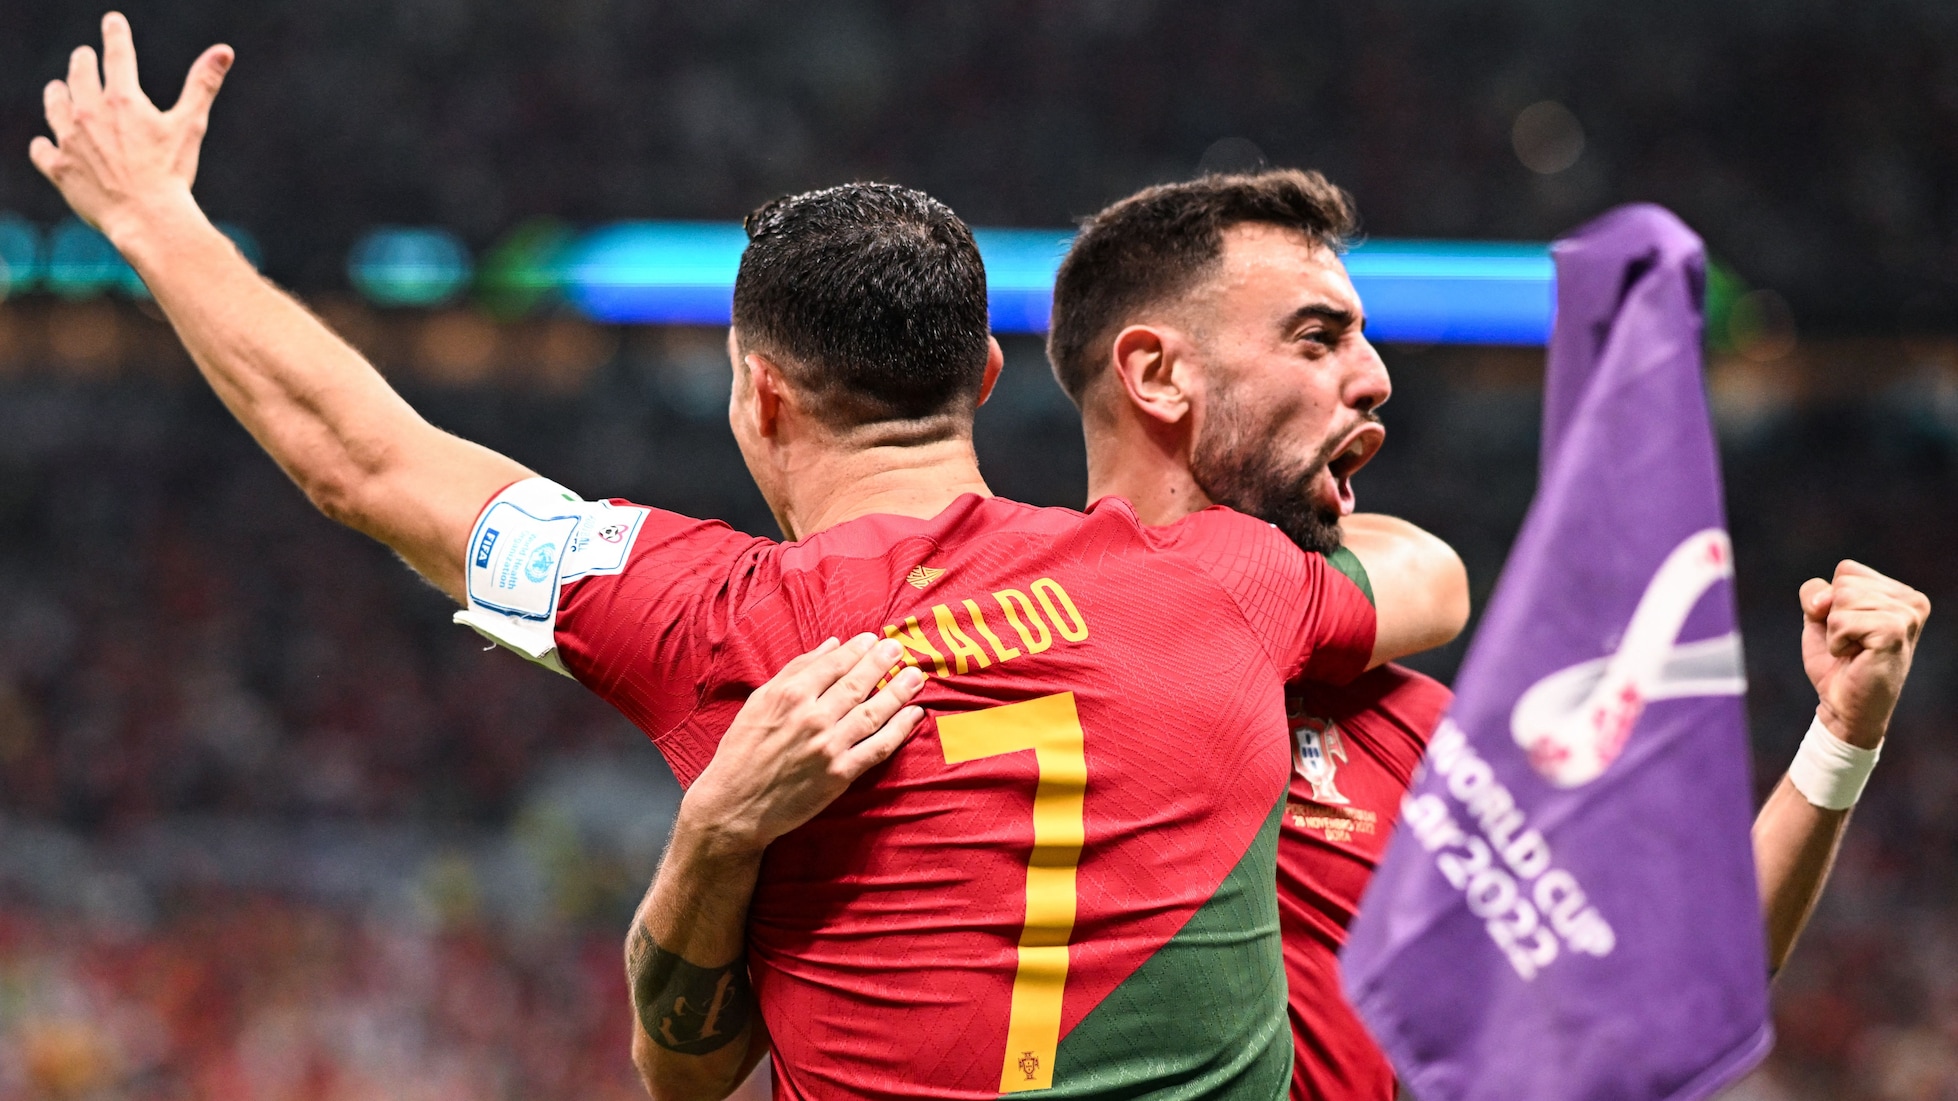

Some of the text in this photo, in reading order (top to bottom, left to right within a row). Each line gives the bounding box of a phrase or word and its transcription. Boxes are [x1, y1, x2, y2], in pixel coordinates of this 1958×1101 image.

[478, 530, 496, 563] FIFA
[507, 557, 523, 590] Health
[876, 577, 1089, 689] NALDO
[936, 692, 1086, 1093] 7
[1400, 790, 1560, 981] ar2022
[1426, 717, 1616, 957] WORLD CUP
